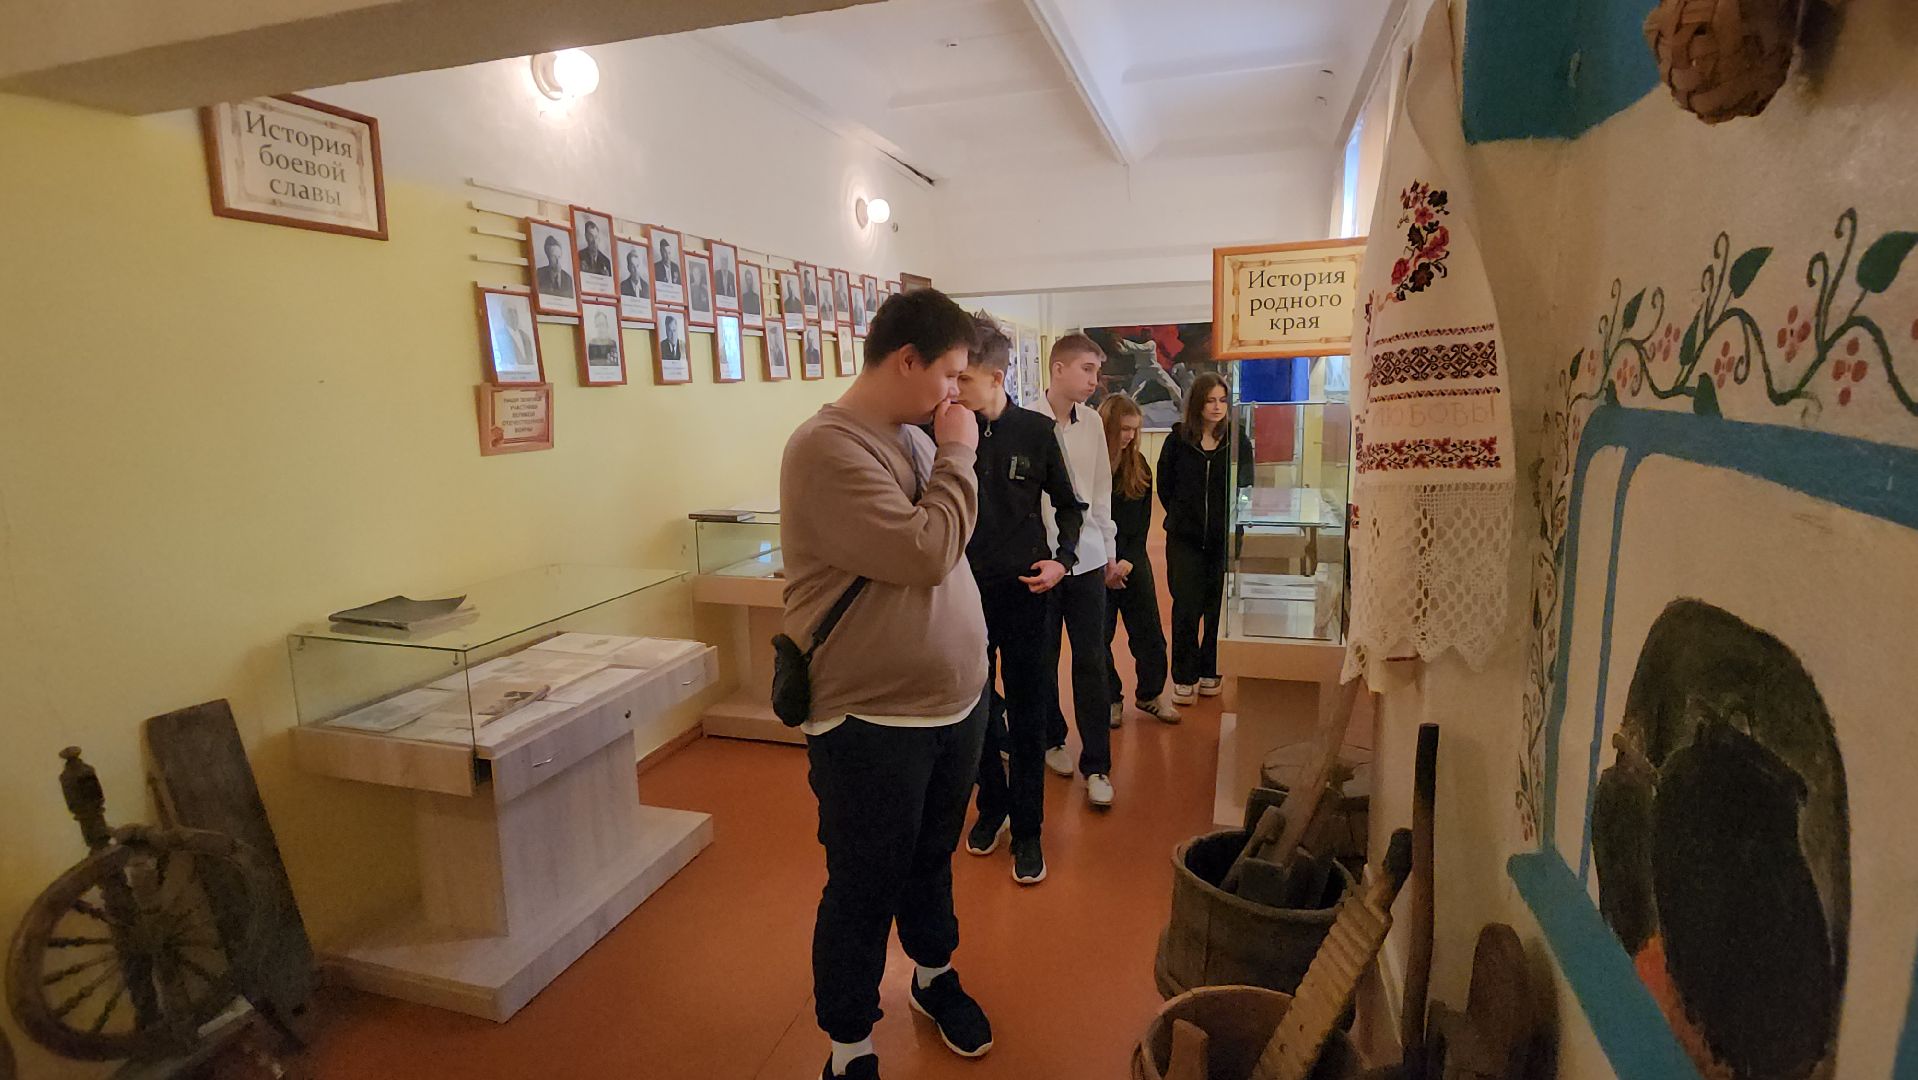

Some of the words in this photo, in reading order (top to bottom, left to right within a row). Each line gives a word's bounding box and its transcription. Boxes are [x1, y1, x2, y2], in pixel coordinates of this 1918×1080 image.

[244, 110, 353, 158] История
[258, 144, 347, 183] боевой
[269, 178, 342, 206] славы
[1248, 270, 1346, 291] История
[1250, 293, 1342, 316] родного
[1269, 316, 1320, 335] края
